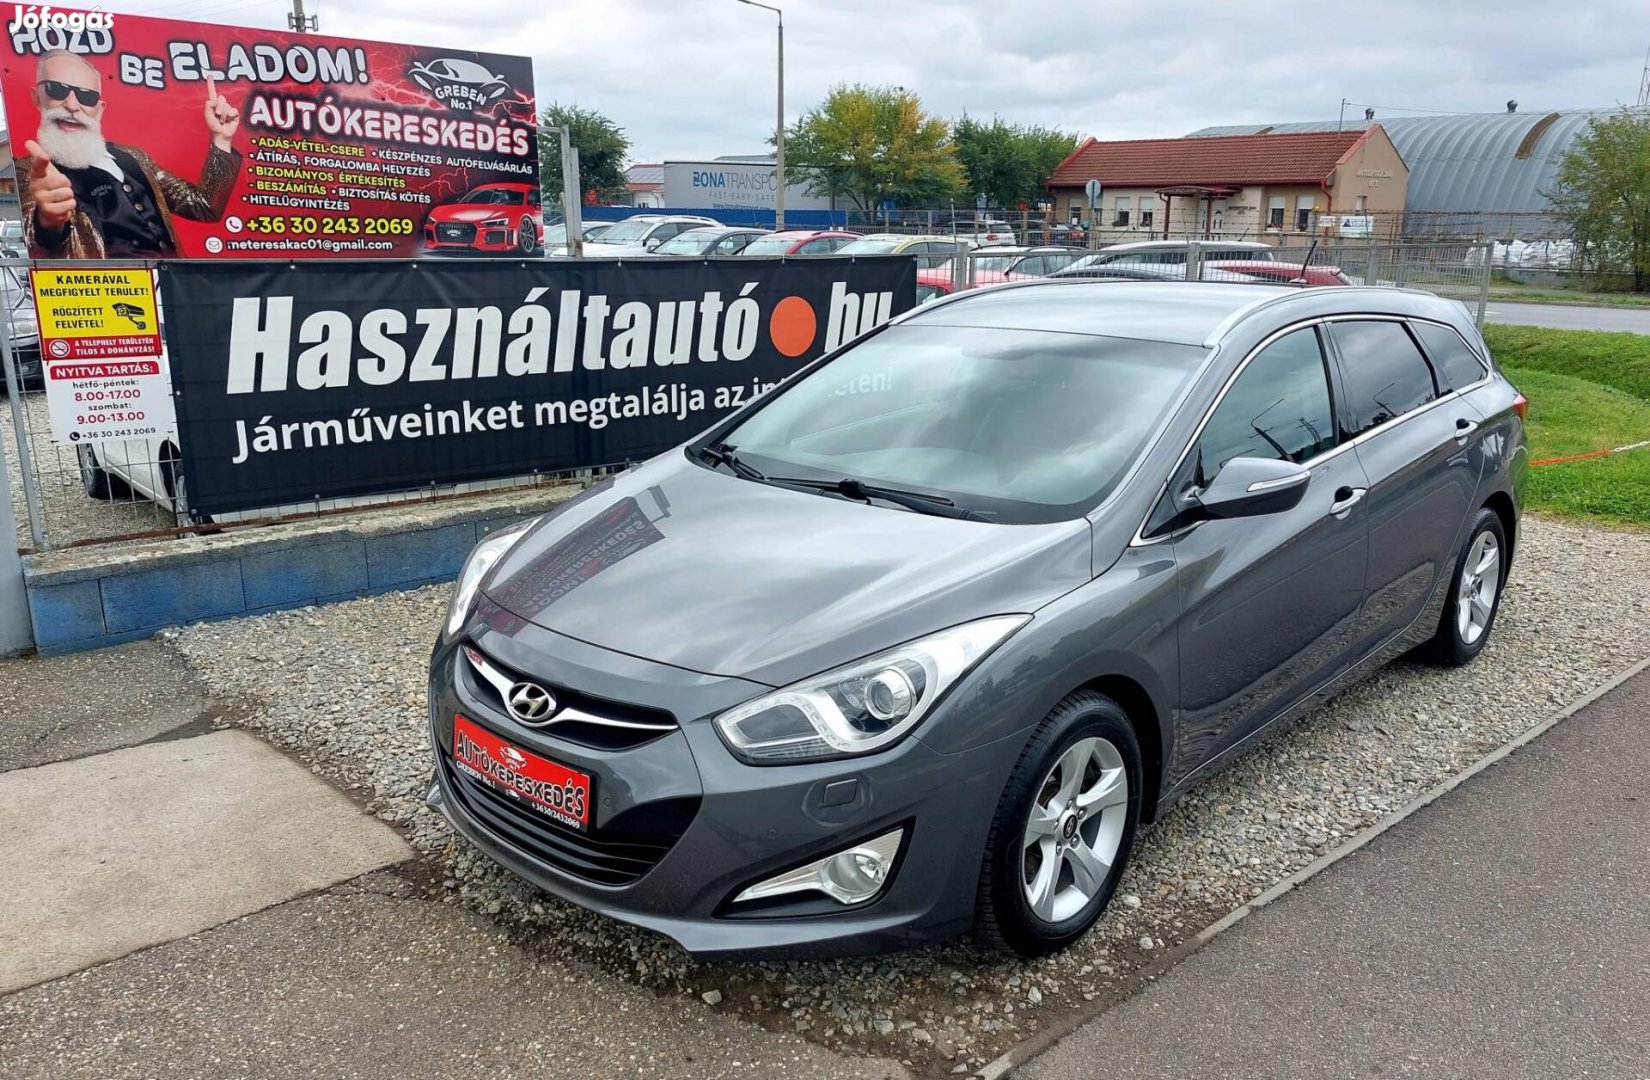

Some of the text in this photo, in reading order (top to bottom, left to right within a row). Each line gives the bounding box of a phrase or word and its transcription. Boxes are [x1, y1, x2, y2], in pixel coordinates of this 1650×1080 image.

[120, 42, 368, 88] BE ELADOM!
[434, 84, 487, 106] GREBEN
[450, 98, 472, 111] No.1
[250, 96, 530, 156] AUTÓKERESKEDÉS
[258, 137, 366, 157] ADÁS-VÉTEL-CSERE
[256, 150, 431, 178] ÁTÍRÁS, FORGALOMBA HELYEZÉS
[379, 149, 533, 175] KÉSZPÉNZES AUTÓFELVÁSÁRLÁS
[256, 166, 406, 188] BIZOMÁNYOS ÉRTÉKESÍTÉS
[256, 180, 327, 195] BESZÁMÍTÁS
[338, 187, 431, 204] BIZTOSÍTÁS KÖTÉS
[249, 195, 351, 211] HITELÜGYINTÉZÉS
[246, 216, 414, 234] +36 30 243 2069
[56, 273, 131, 285] KAMERÁVAL
[39, 286, 149, 297] MEGFIGYELT TERÜLET!
[52, 305, 104, 317] RÖGZÍTETT
[55, 318, 104, 328] FELVÉTEL!
[81, 339, 117, 347] TELEPHELY
[118, 337, 154, 345] TERÜLETÉN
[76, 347, 98, 355] TILOS
[107, 344, 155, 354] DOHÁNYZÁS!
[56, 363, 153, 377] NYITVA TARTÁS:
[73, 379, 140, 390] hétfő-péntek:
[74, 389, 141, 402] 8.00-17.00
[88, 402, 132, 411] szombat:
[77, 411, 145, 425] 9.00-13.00
[231, 400, 524, 464] Járműveinket
[535, 383, 705, 430] megtalálja
[714, 386, 745, 407] az
[82, 427, 156, 439] +36 30 243 2069
[456, 729, 586, 819] AUTÓKERESKEDÉS
